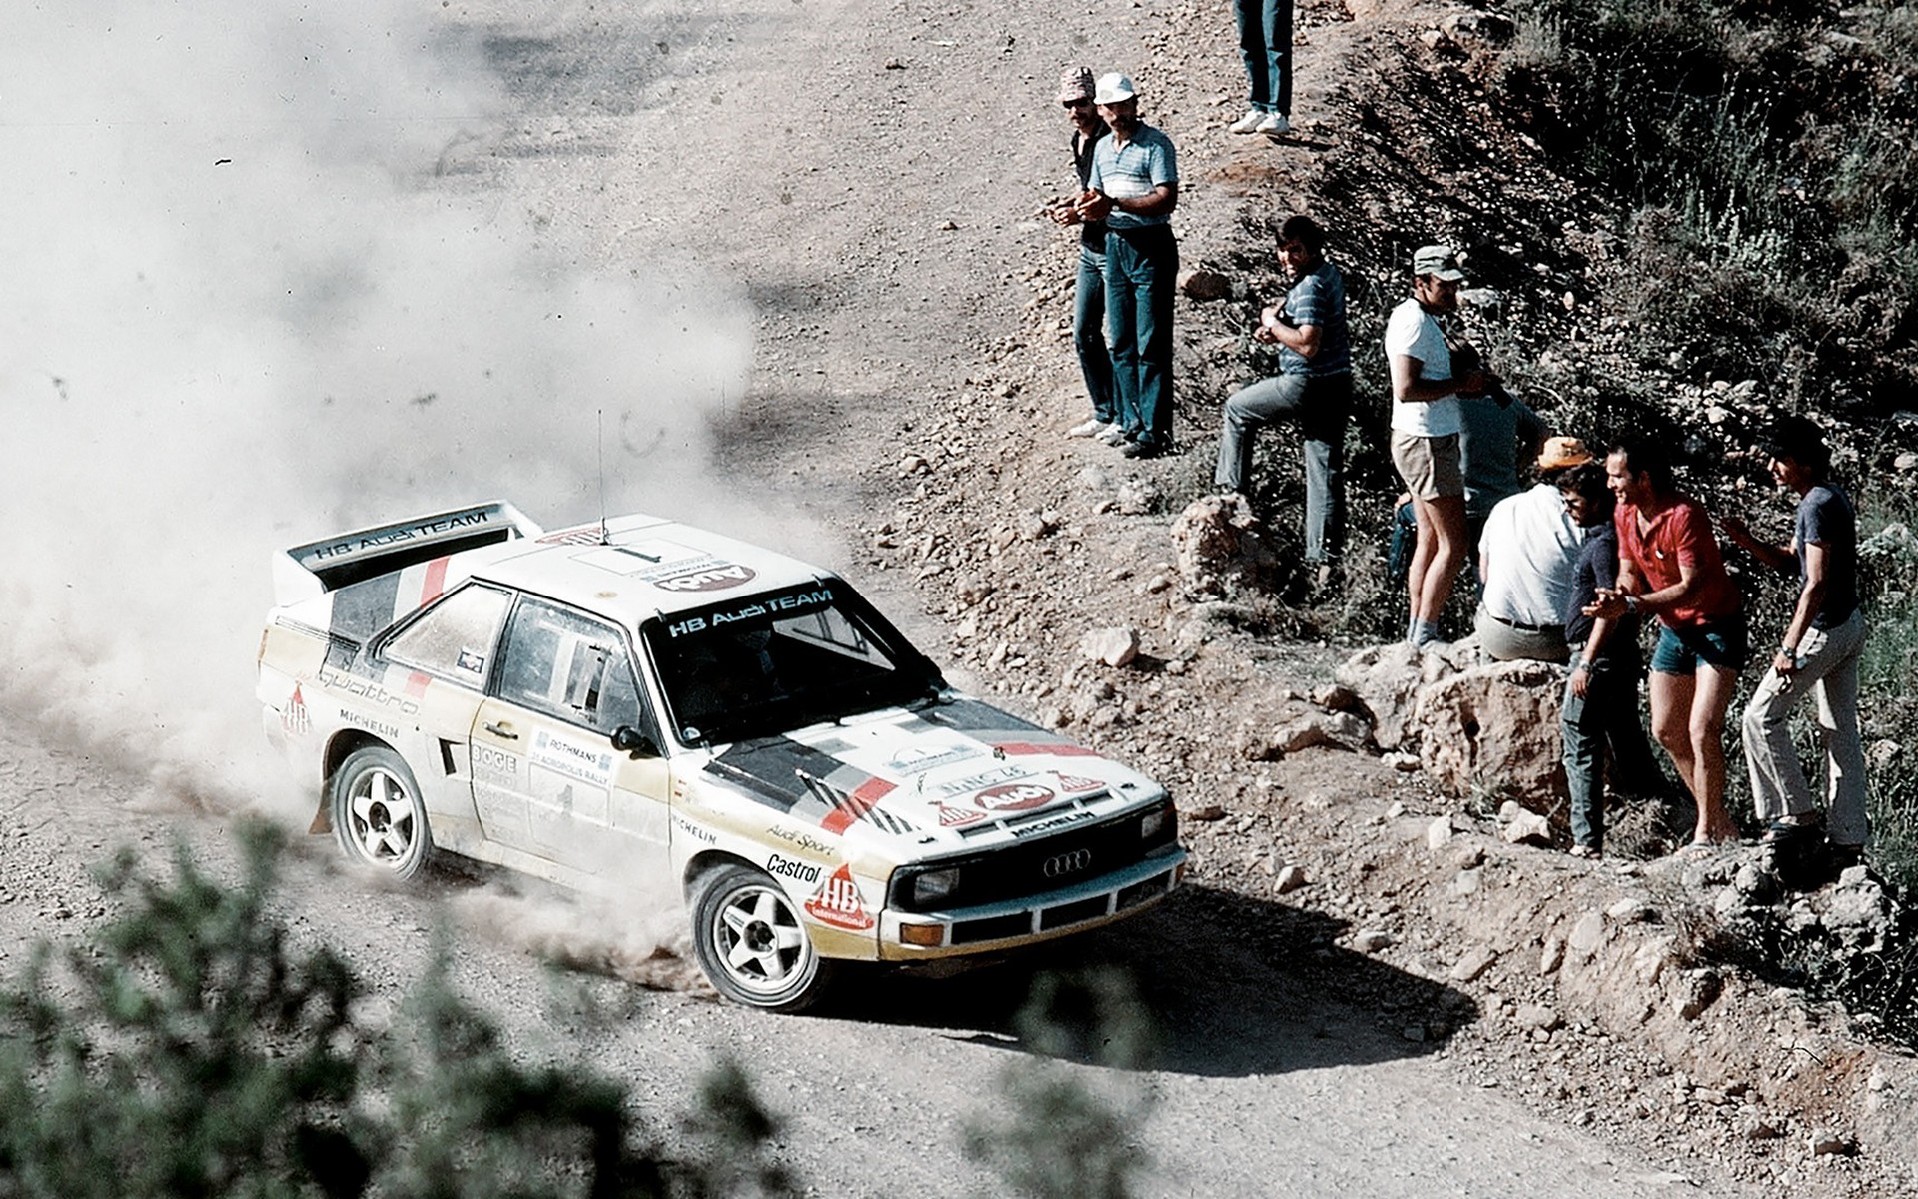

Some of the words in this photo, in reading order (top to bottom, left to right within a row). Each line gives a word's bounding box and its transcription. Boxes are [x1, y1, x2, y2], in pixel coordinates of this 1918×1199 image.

[315, 543, 352, 559] HB
[415, 512, 488, 537] TEAM
[669, 616, 707, 638] HB
[765, 589, 833, 612] TEAM
[320, 671, 420, 715] quattro
[340, 709, 399, 738] MICHELIN
[549, 739, 597, 763] ROTHMANS
[766, 824, 797, 845] Audi
[797, 833, 836, 857] Sport
[1011, 811, 1096, 838] MICHELIN
[766, 853, 822, 884] Castrol
[818, 875, 861, 914] HB
